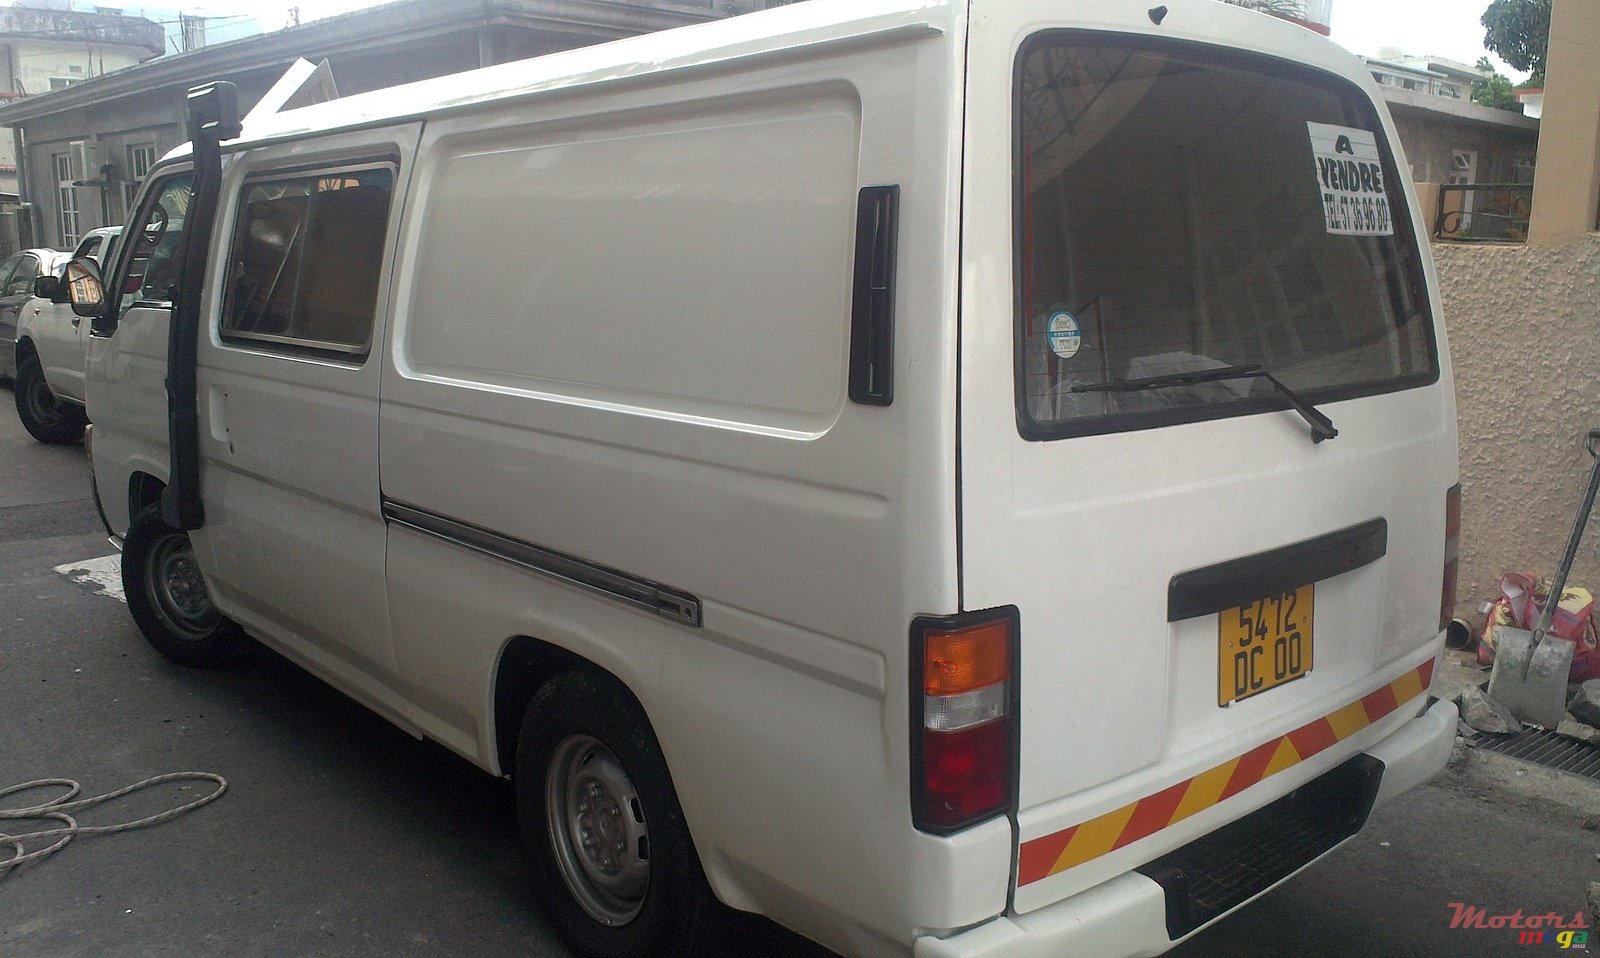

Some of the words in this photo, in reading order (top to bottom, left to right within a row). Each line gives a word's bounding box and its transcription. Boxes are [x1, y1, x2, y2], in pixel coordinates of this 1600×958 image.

[1335, 134, 1354, 155] A
[1318, 156, 1383, 193] VENDRE
[1350, 197, 1363, 231] 36
[1363, 197, 1376, 231] 96
[1235, 645, 1264, 697] DC
[1275, 632, 1301, 681] 00
